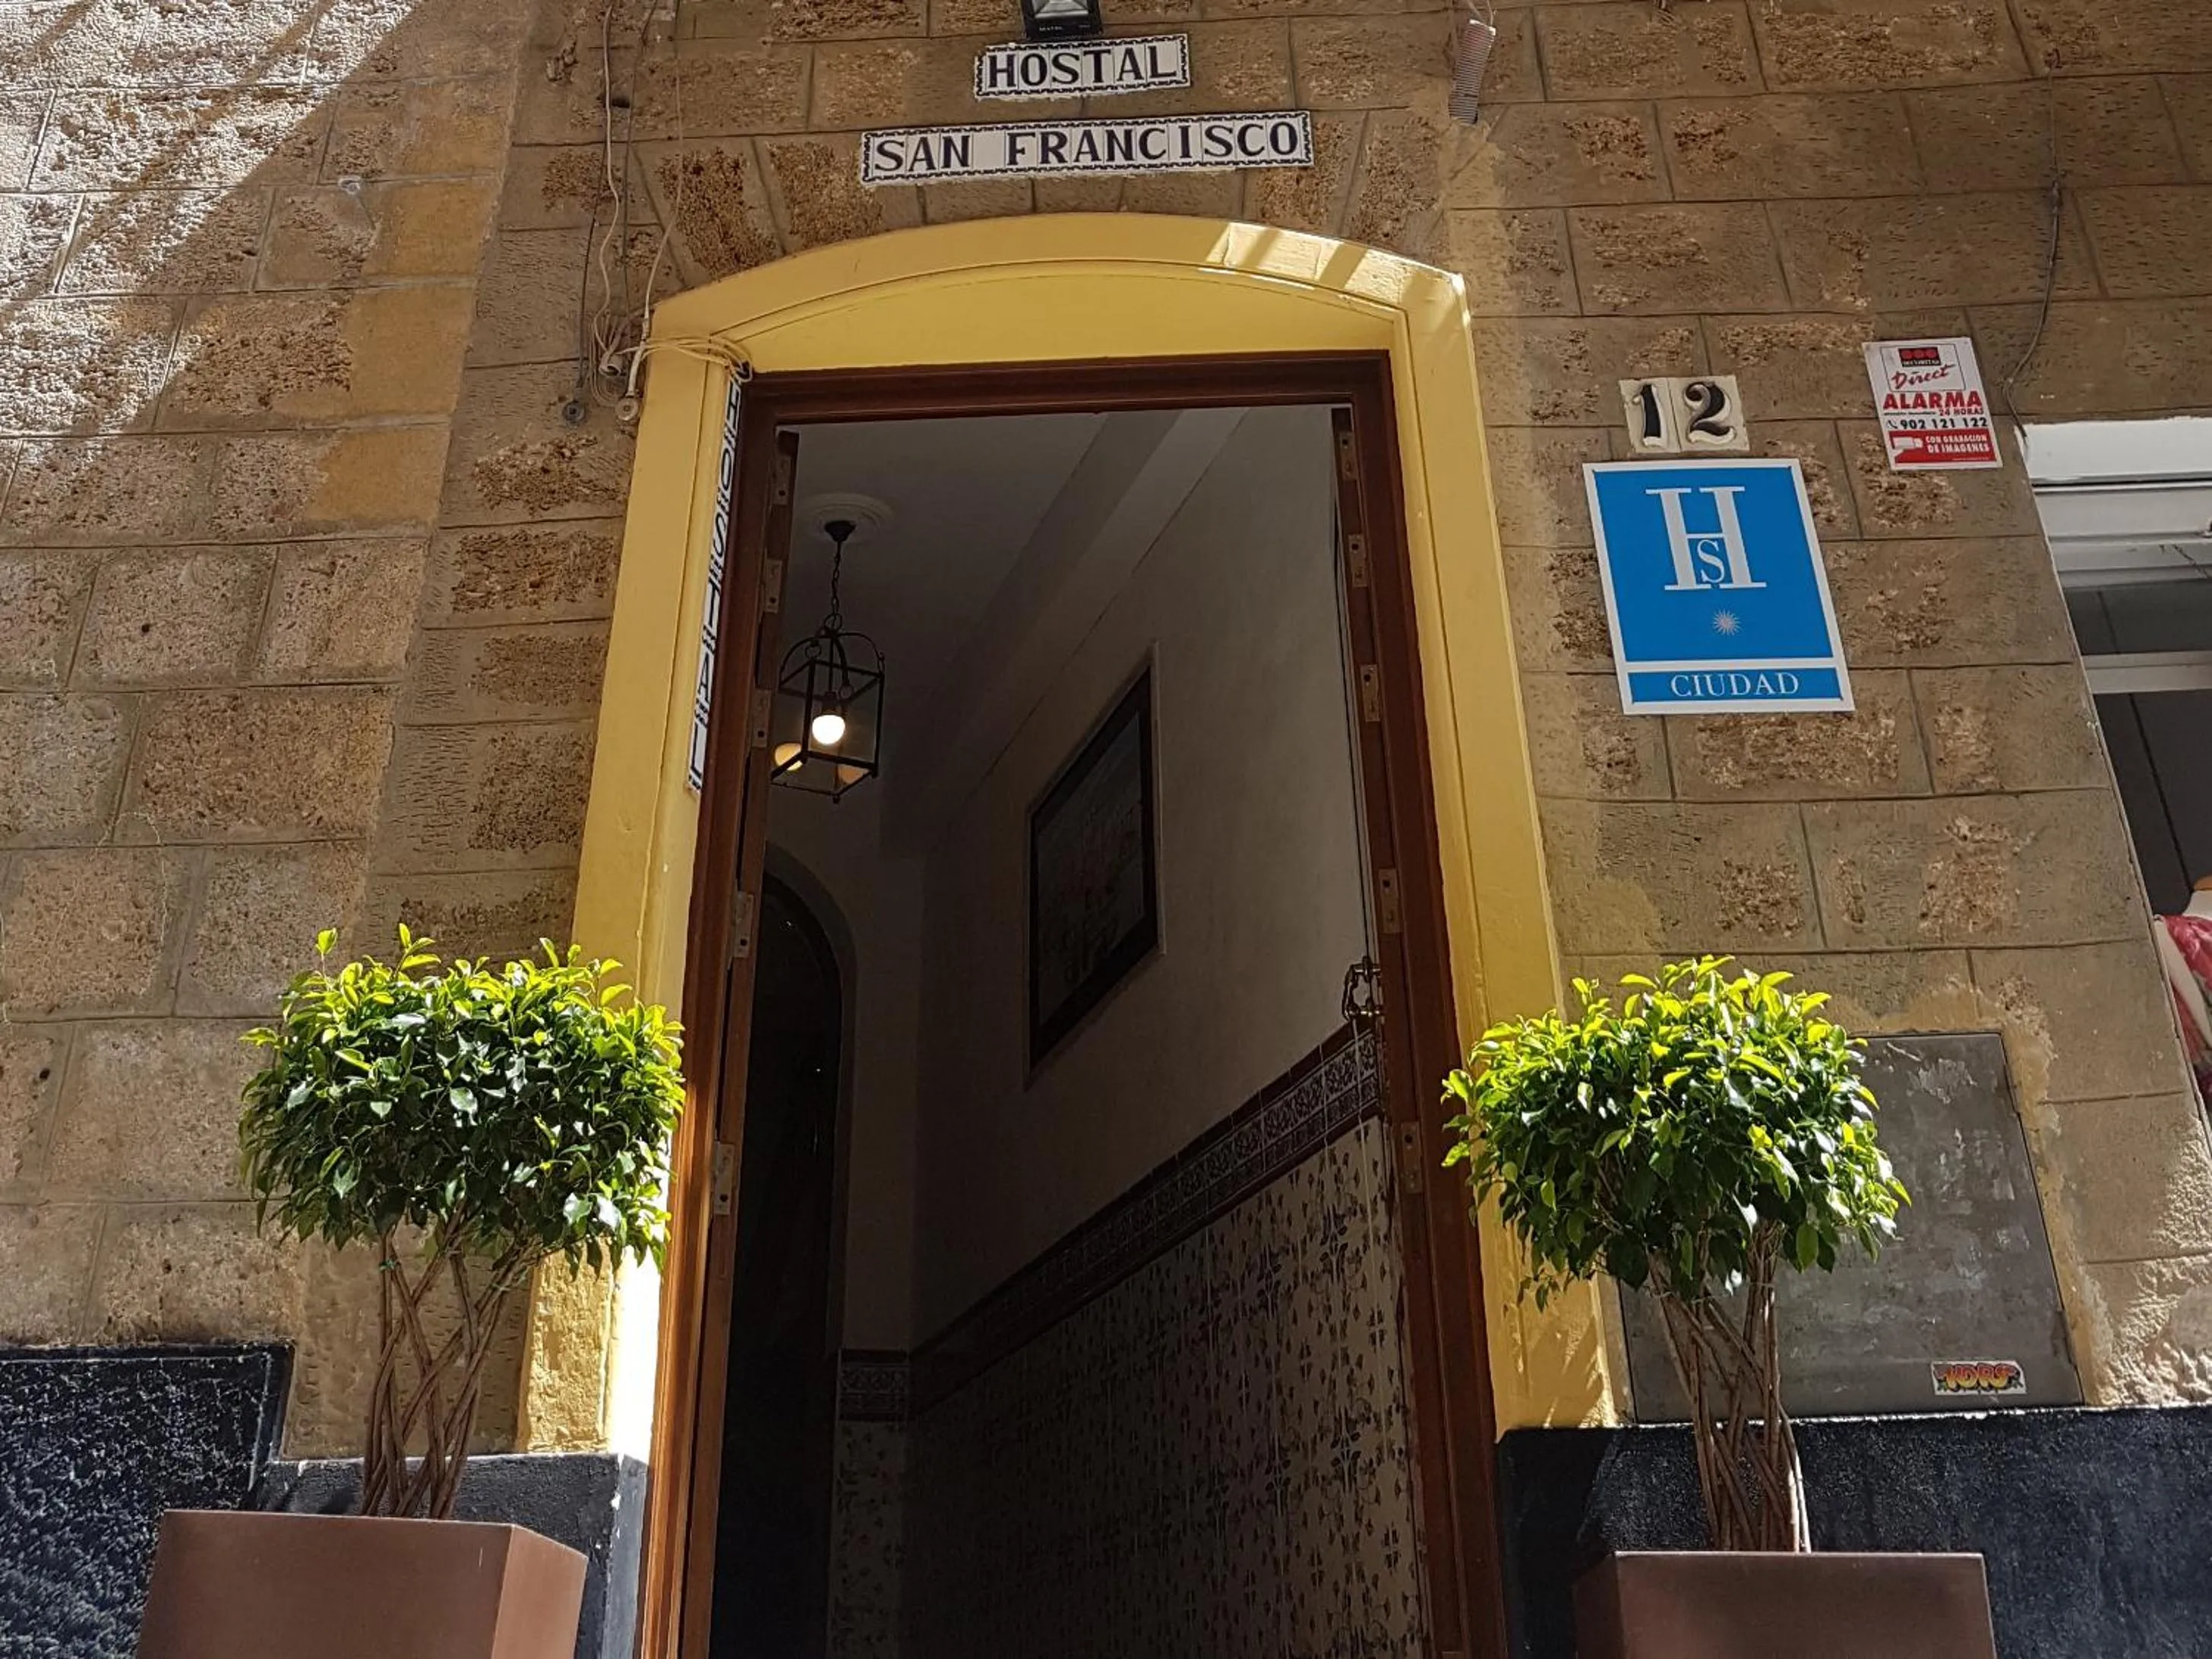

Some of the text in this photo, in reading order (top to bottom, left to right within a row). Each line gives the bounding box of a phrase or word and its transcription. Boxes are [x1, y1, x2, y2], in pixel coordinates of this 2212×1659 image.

[988, 46, 1177, 88] HOSTAL
[874, 122, 1299, 172] SAN FRANCISCO
[1891, 363, 1958, 390] Direct
[1882, 390, 1983, 409] ALARMA
[1939, 408, 1951, 416] 24
[1632, 381, 1738, 449] 12
[1900, 416, 1988, 430] 902 121 122
[687, 381, 742, 782] HOSTAL
[1670, 672, 1800, 697] CIUDAD
